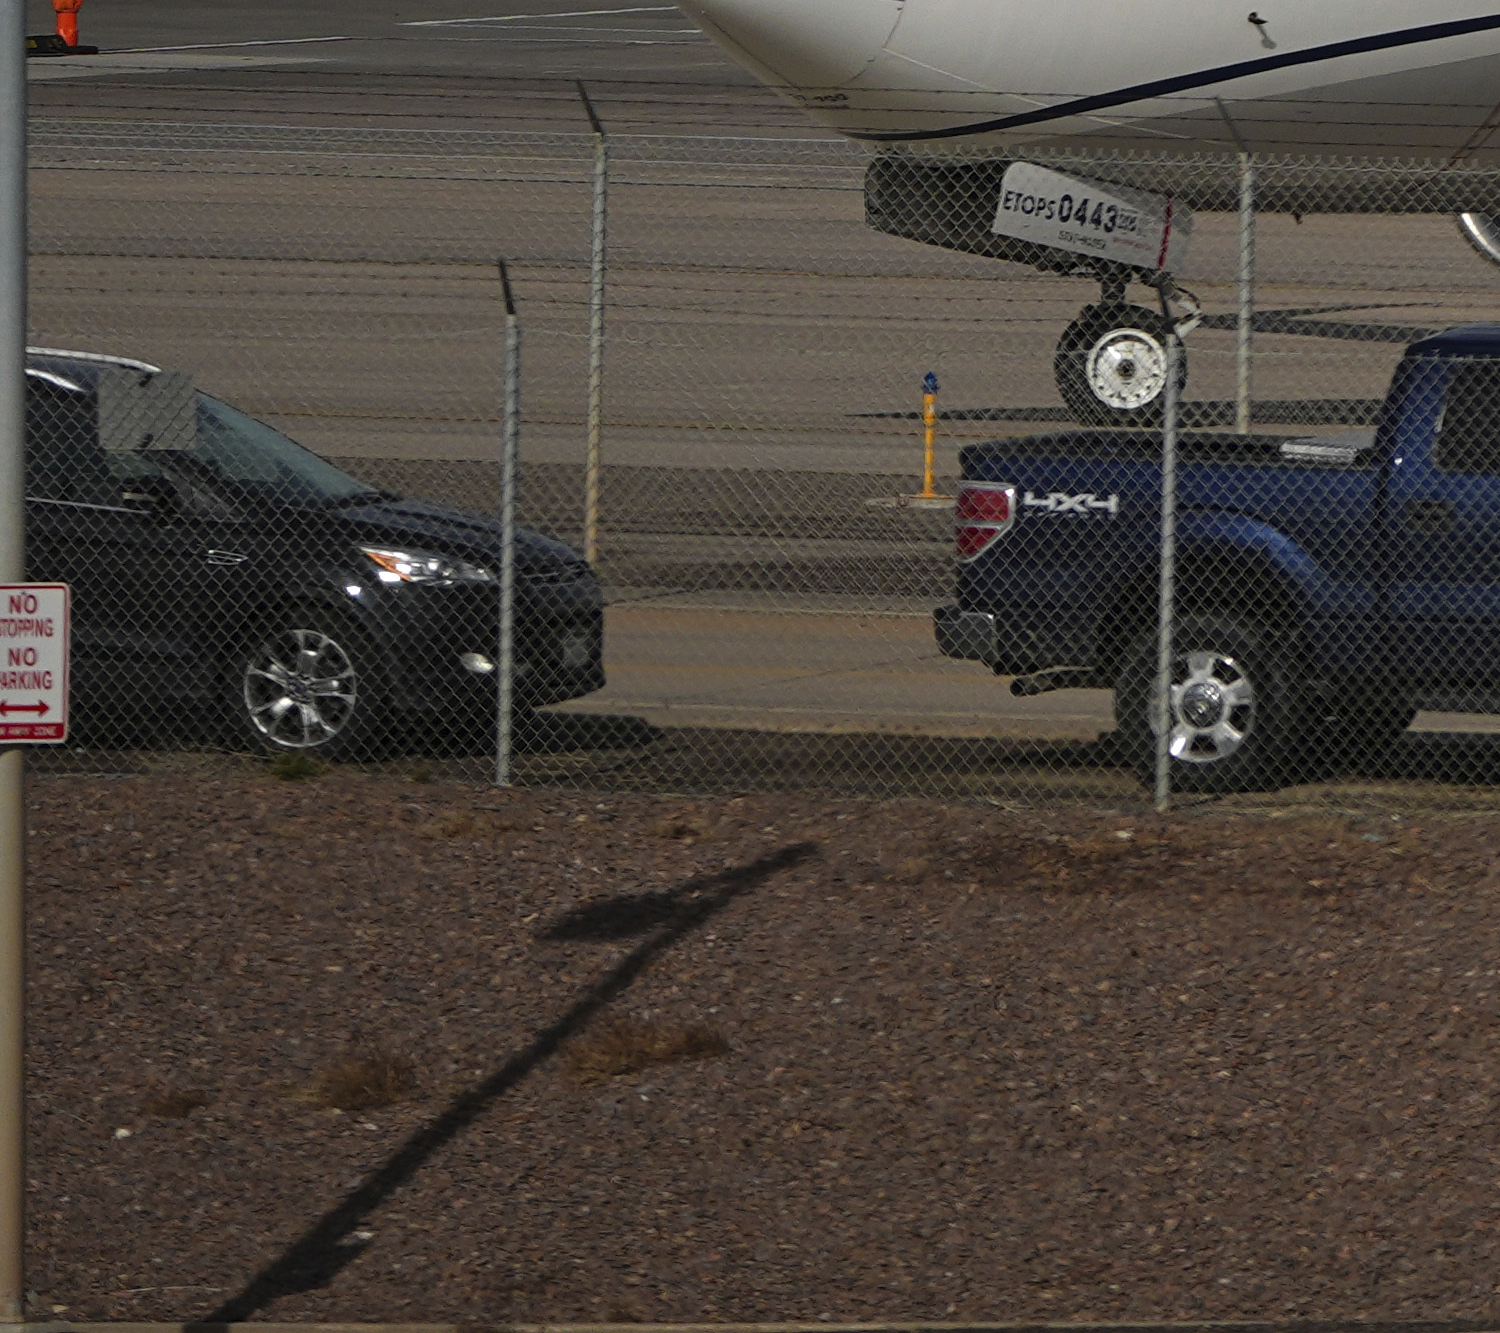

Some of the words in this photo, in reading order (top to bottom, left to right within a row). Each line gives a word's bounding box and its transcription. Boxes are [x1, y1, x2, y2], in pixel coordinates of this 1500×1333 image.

[1003, 190, 1056, 220] ETOPS
[1057, 194, 1119, 232] 0443
[9, 595, 38, 614] NO
[0, 618, 54, 637] TOPPING
[8, 647, 38, 667] NO
[0, 670, 53, 690] ARKING
